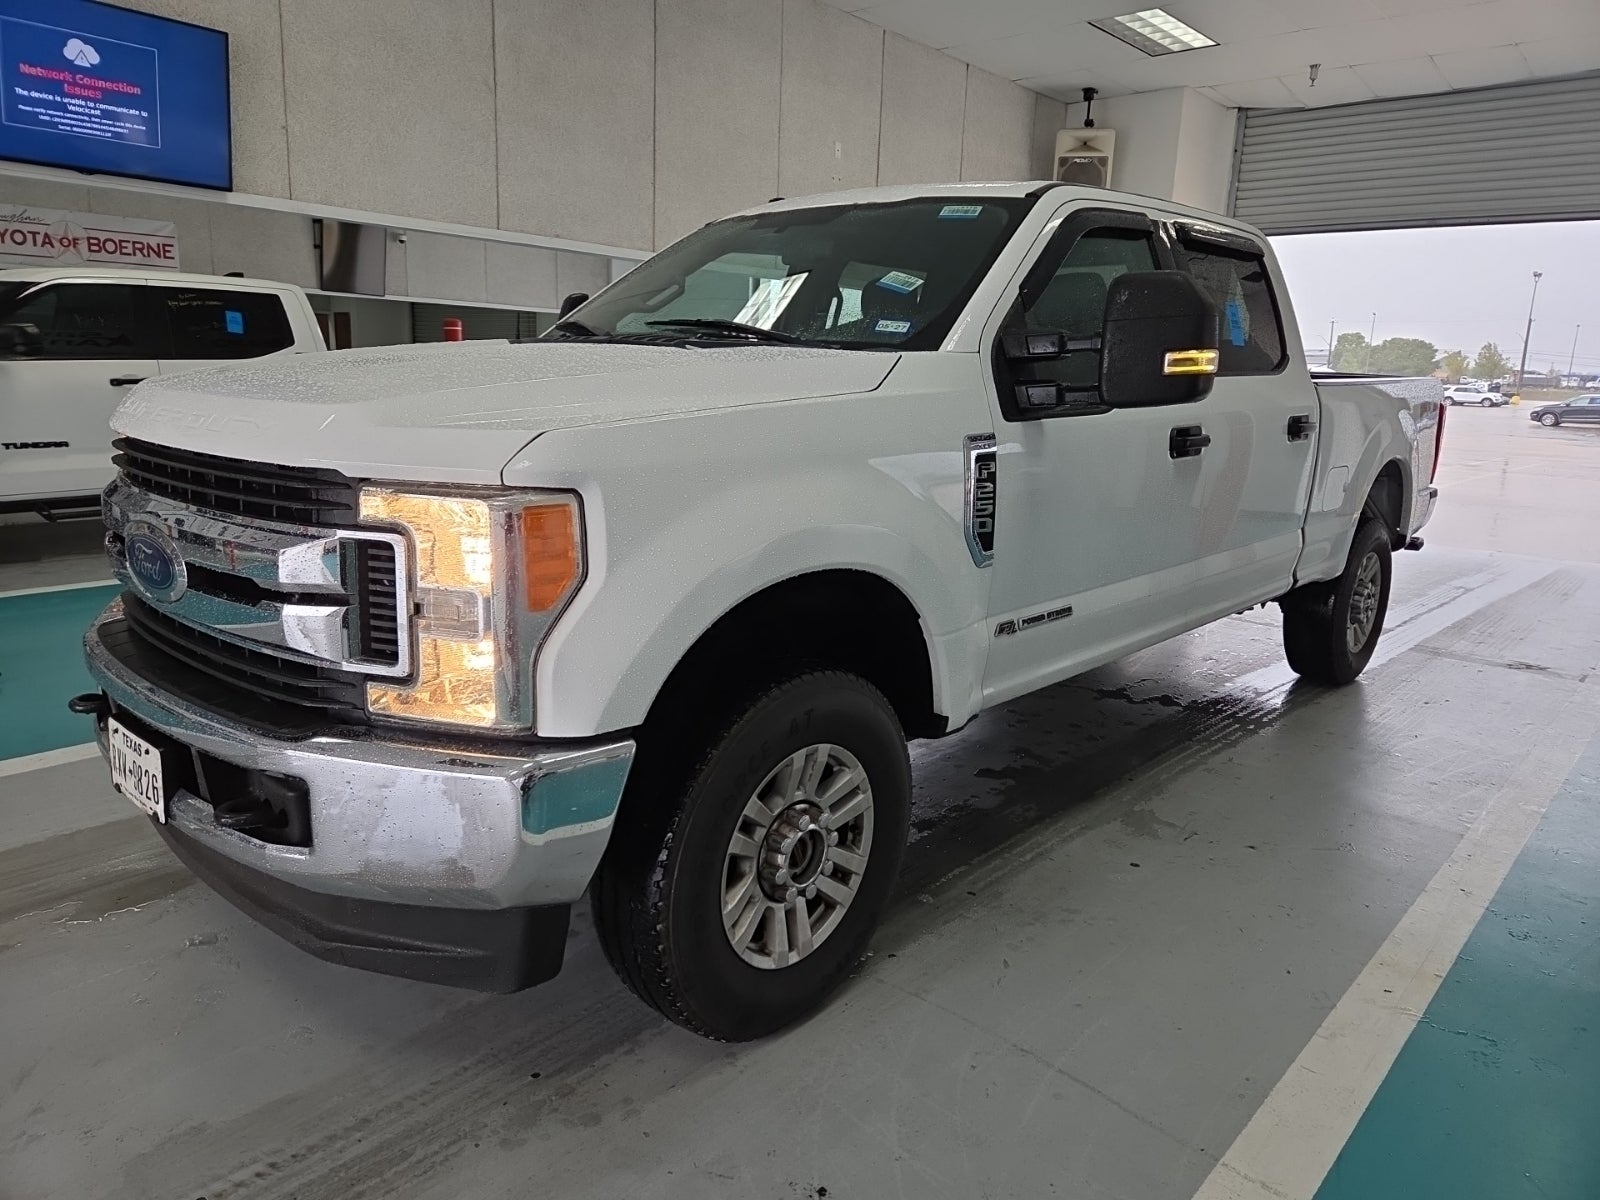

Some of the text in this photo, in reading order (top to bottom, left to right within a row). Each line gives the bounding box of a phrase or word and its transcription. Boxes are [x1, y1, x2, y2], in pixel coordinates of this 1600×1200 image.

[19, 63, 141, 95] Network Connection
[64, 83, 102, 99] Issues
[14, 86, 29, 96] The
[29, 90, 54, 101] device
[54, 94, 61, 102] is
[62, 97, 86, 107] unable
[95, 103, 140, 116] communicate
[67, 104, 102, 116] Velocicast
[59, 236, 80, 249] OF
[86, 236, 175, 260] BOERNE
[1, 441, 69, 450] TUNDRA
[133, 542, 162, 581] Ford
[122, 733, 142, 757] TEXAS
